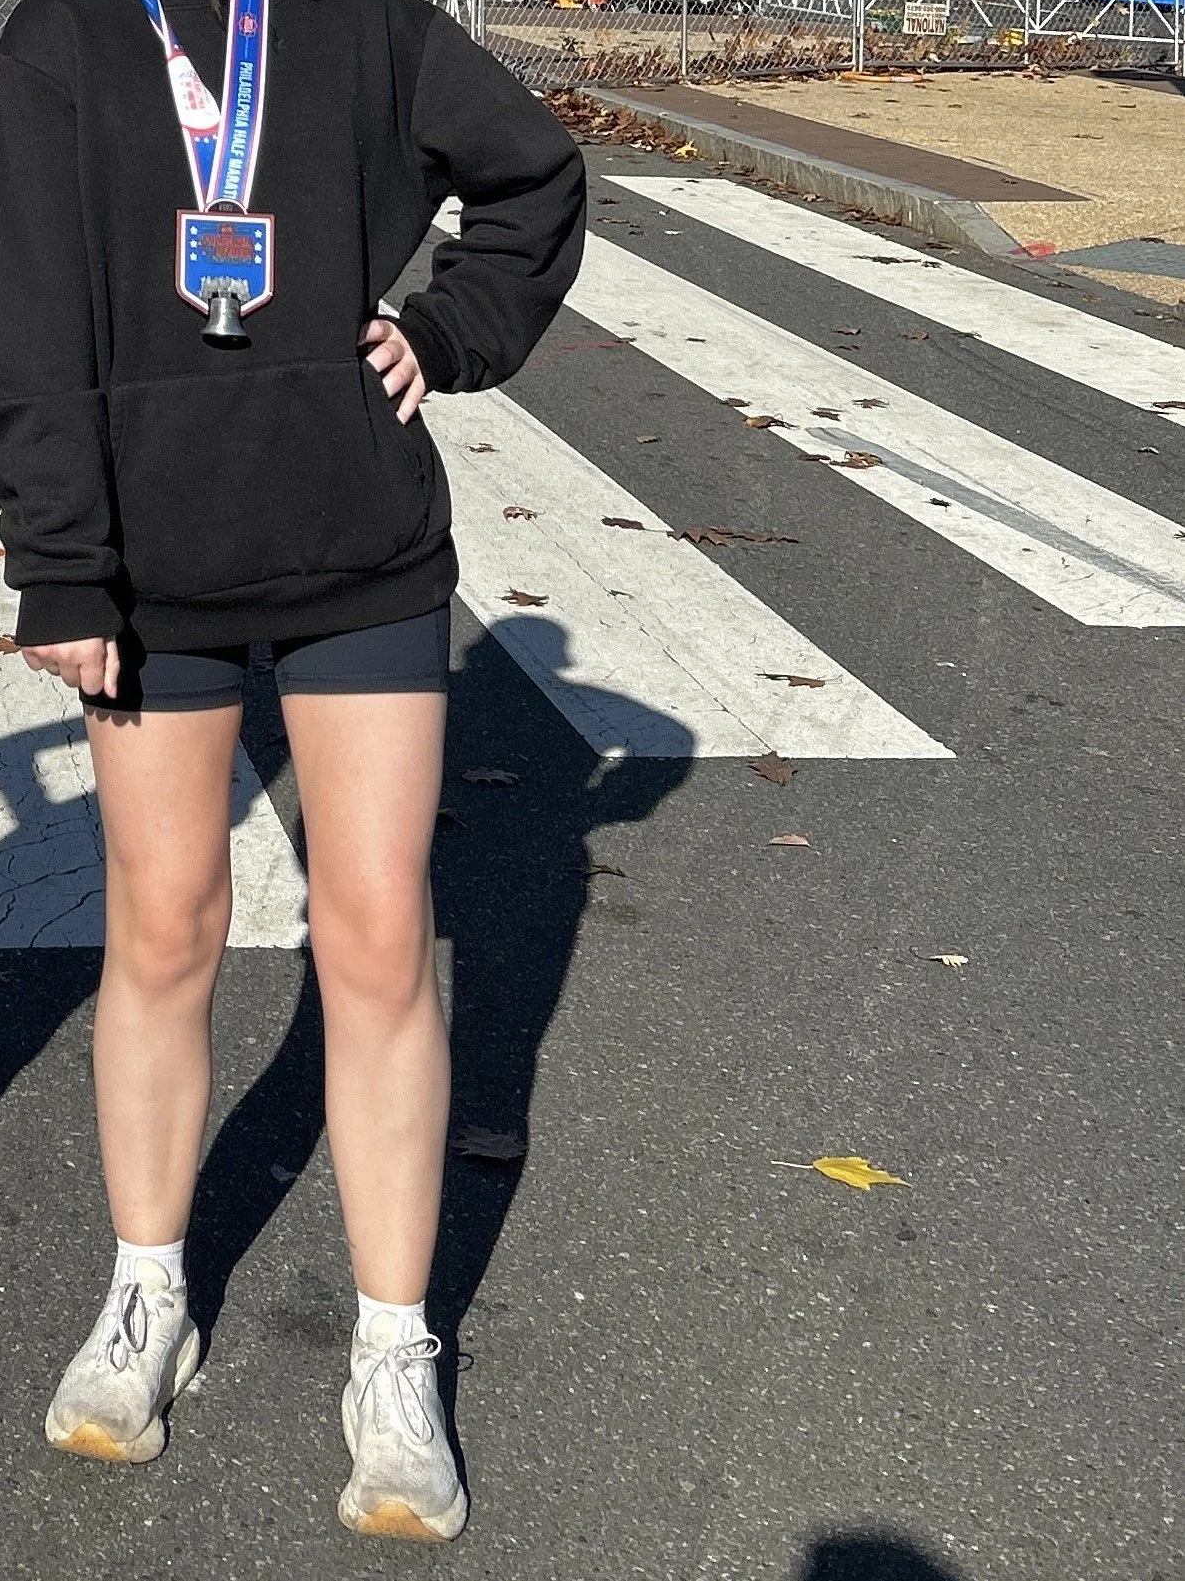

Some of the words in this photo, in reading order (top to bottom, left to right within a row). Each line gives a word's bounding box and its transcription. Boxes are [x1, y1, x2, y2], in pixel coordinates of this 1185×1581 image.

[234, 61, 254, 127] PHILADELPHIA
[230, 129, 248, 158] HALF
[223, 158, 243, 199] MARAT
